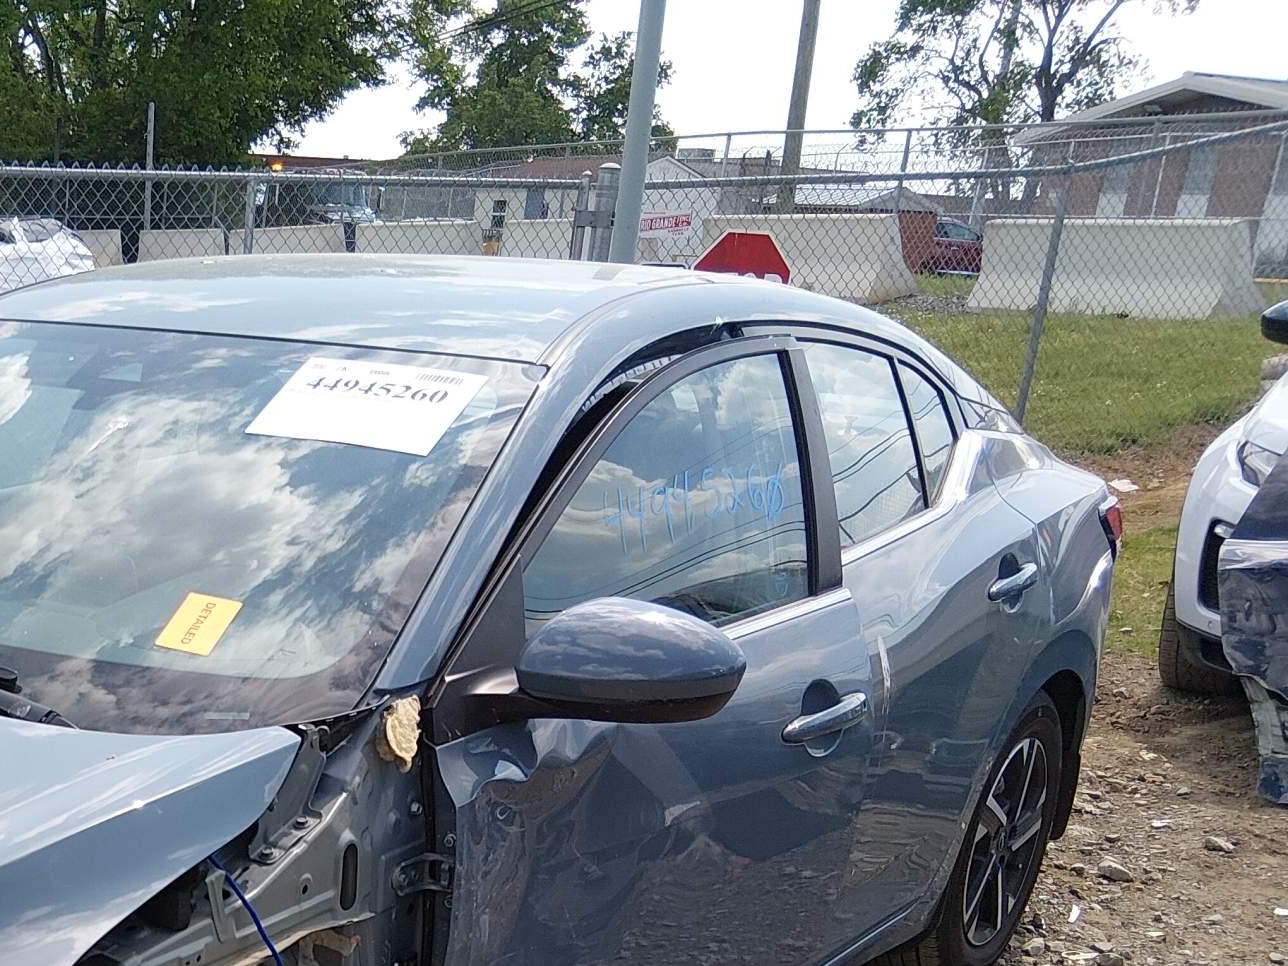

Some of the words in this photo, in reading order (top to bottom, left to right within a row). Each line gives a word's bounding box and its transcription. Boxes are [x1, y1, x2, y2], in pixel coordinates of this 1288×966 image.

[651, 216, 676, 229] GRANDE
[306, 375, 450, 404] 44945260
[180, 602, 217, 645] DETAILED
